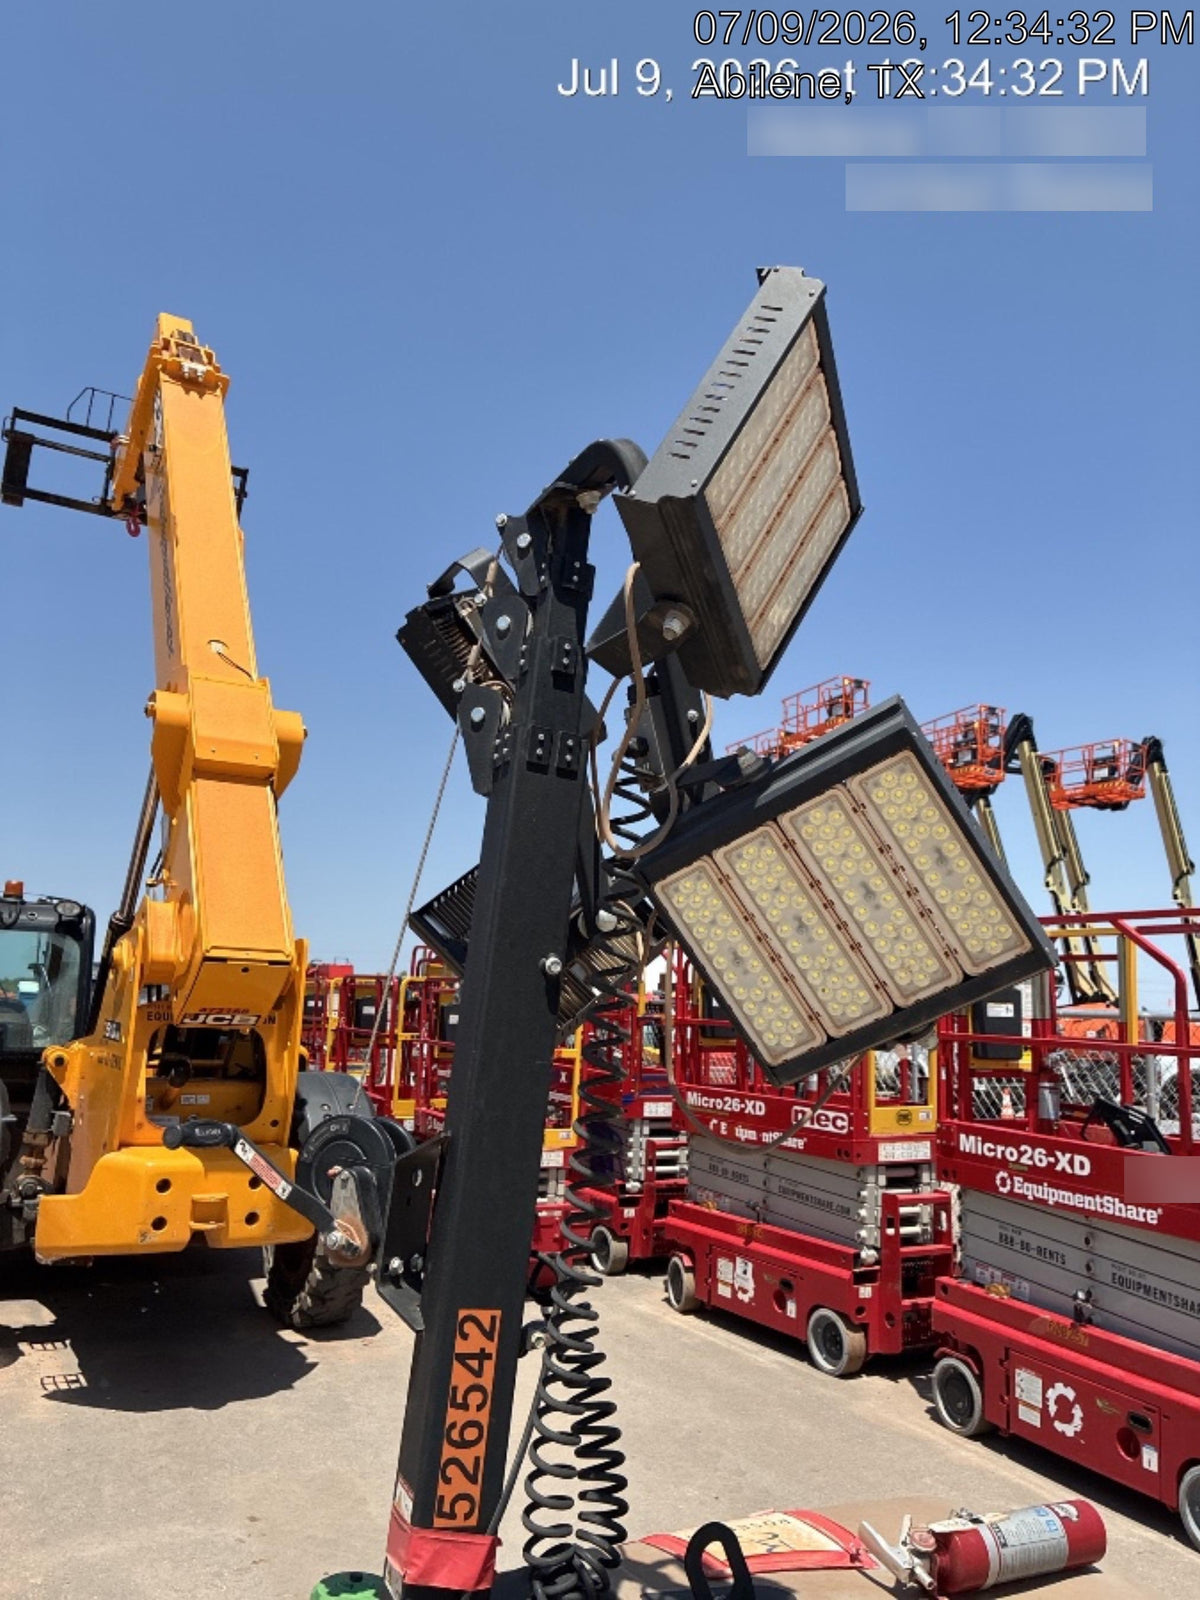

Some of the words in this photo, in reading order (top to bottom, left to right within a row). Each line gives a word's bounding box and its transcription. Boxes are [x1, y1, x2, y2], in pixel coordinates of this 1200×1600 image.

[686, 1091, 766, 1117] Micro26-XD
[793, 1106, 849, 1133] mec
[959, 1133, 1091, 1177] Micro26-XD
[1013, 1175, 1160, 1225] EquipmentShare
[436, 1313, 498, 1522] 526542
